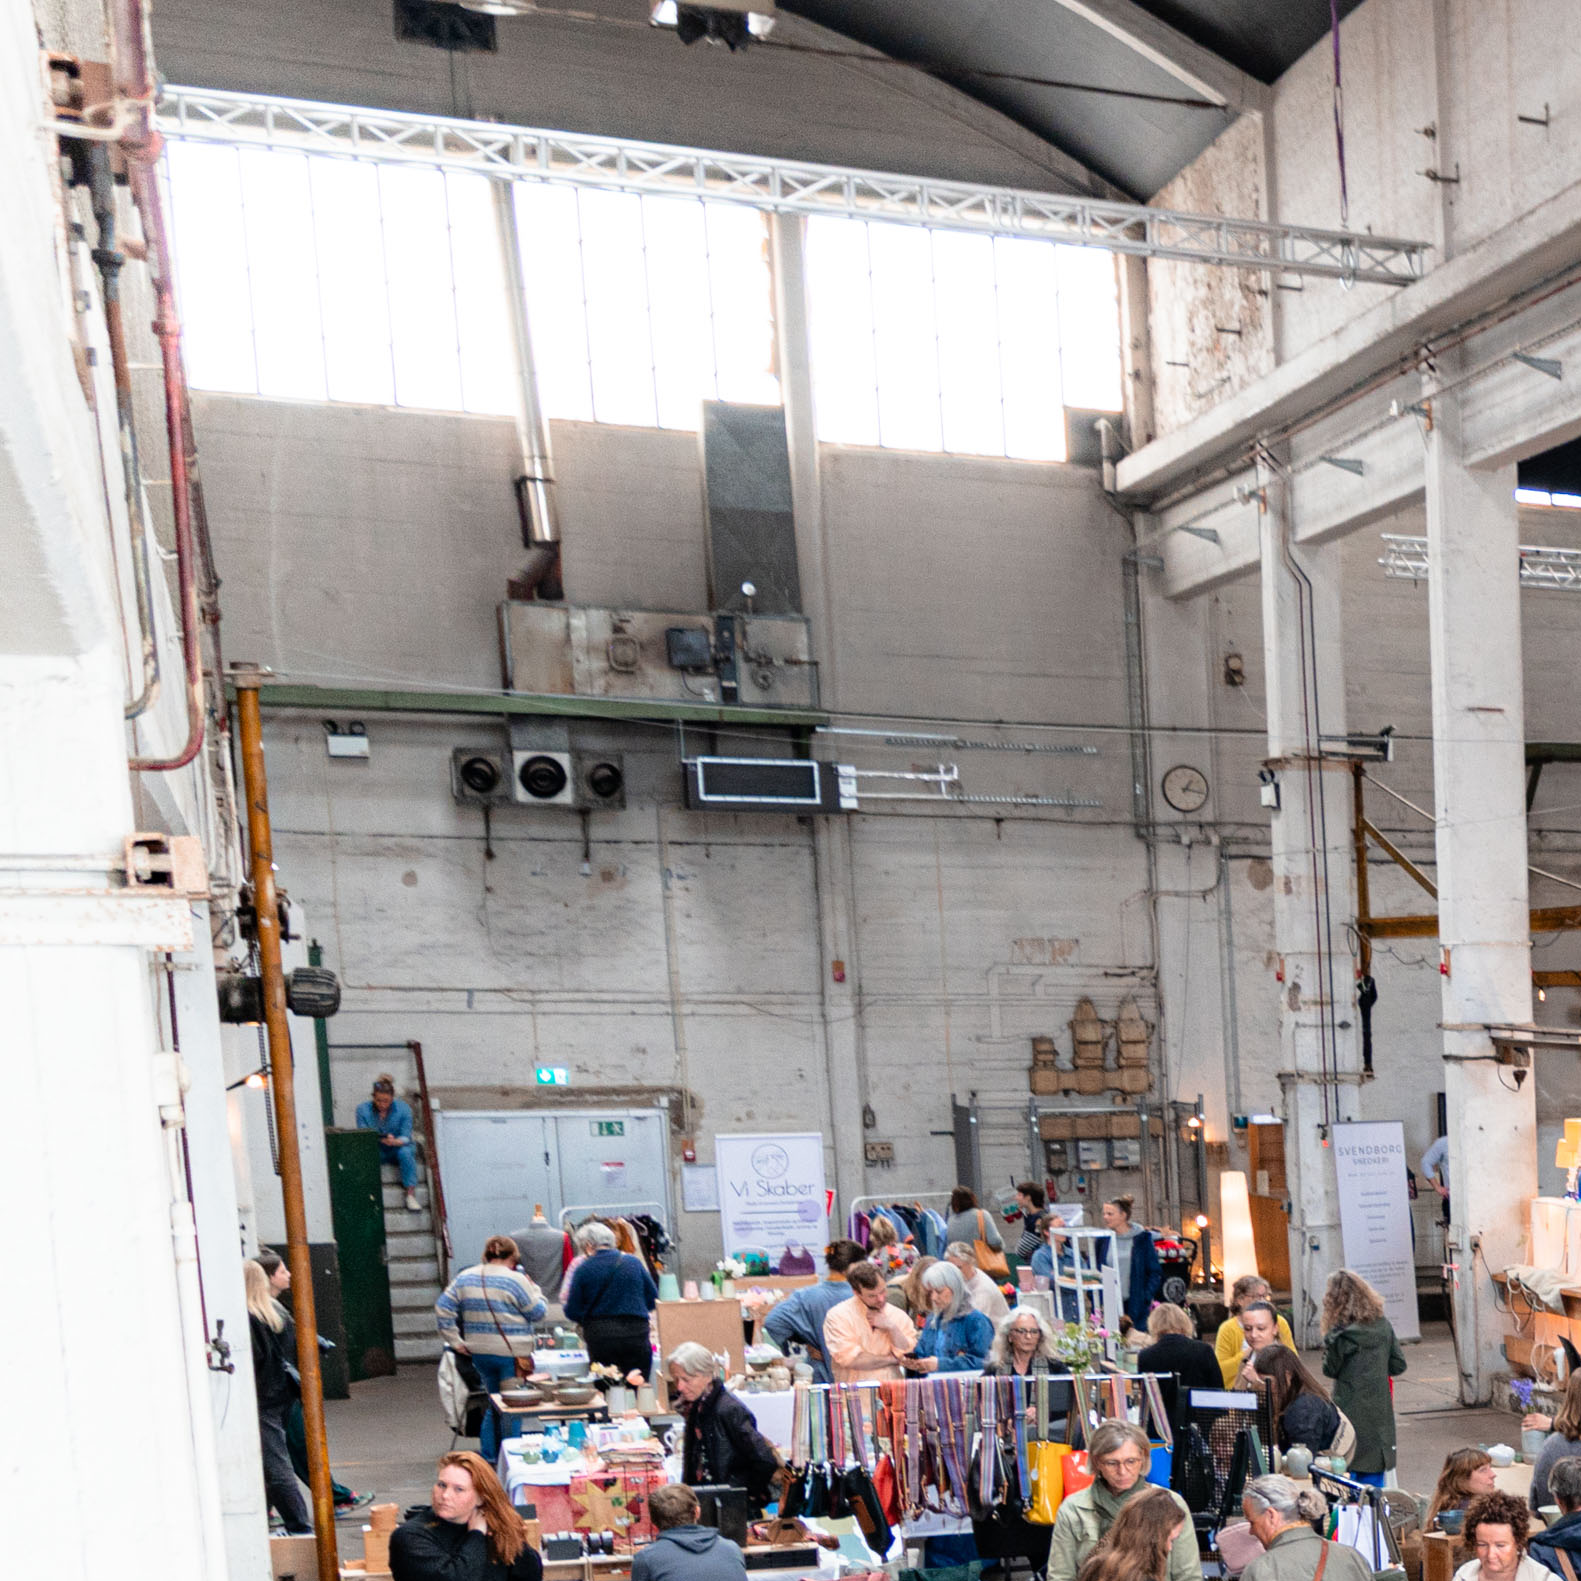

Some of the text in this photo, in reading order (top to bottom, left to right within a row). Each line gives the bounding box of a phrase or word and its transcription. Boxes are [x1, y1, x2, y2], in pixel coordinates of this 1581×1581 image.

[1338, 1144, 1402, 1157] SVENDBORG
[730, 1180, 749, 1197] Vi
[756, 1179, 815, 1197] Skaber
